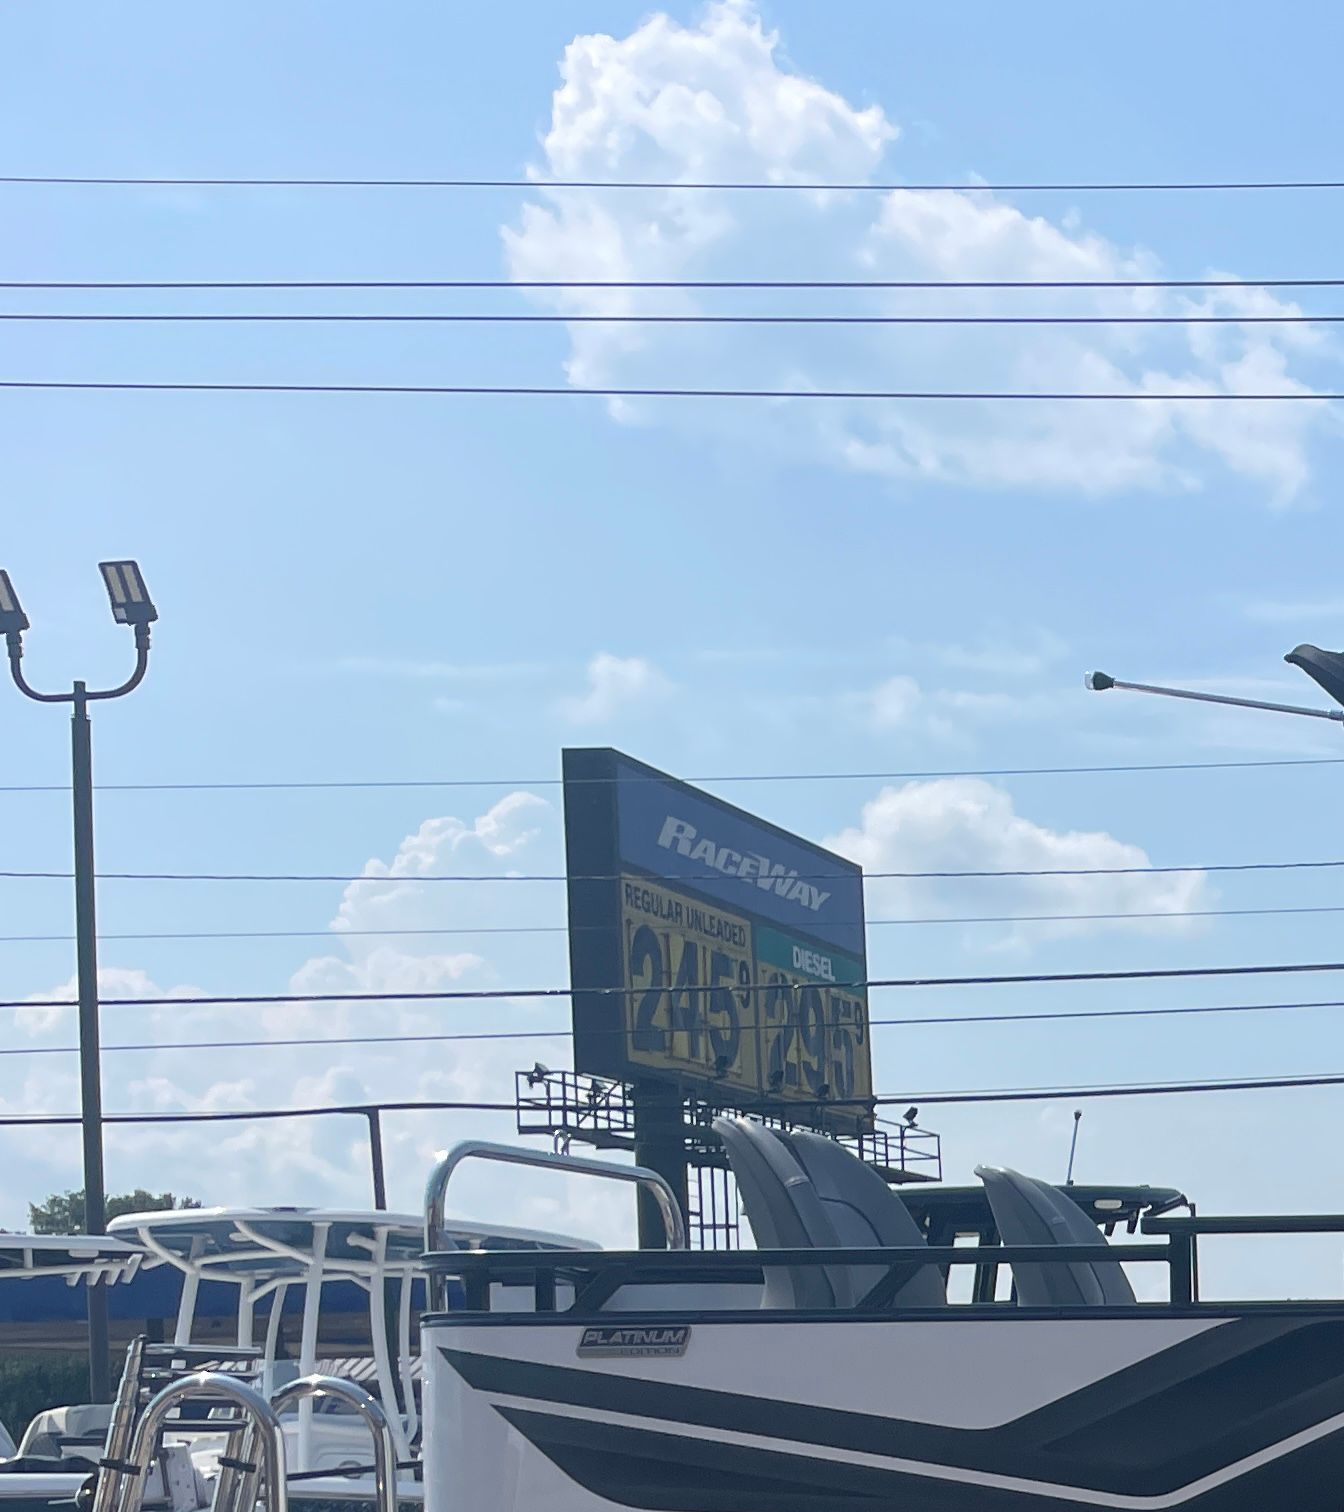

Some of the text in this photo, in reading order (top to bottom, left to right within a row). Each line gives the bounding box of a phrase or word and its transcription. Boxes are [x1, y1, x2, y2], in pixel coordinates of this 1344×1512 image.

[625, 883, 746, 947] REGULAR UNLEADED
[792, 945, 836, 982] DIESEL
[582, 1328, 685, 1345] PLATINUM
